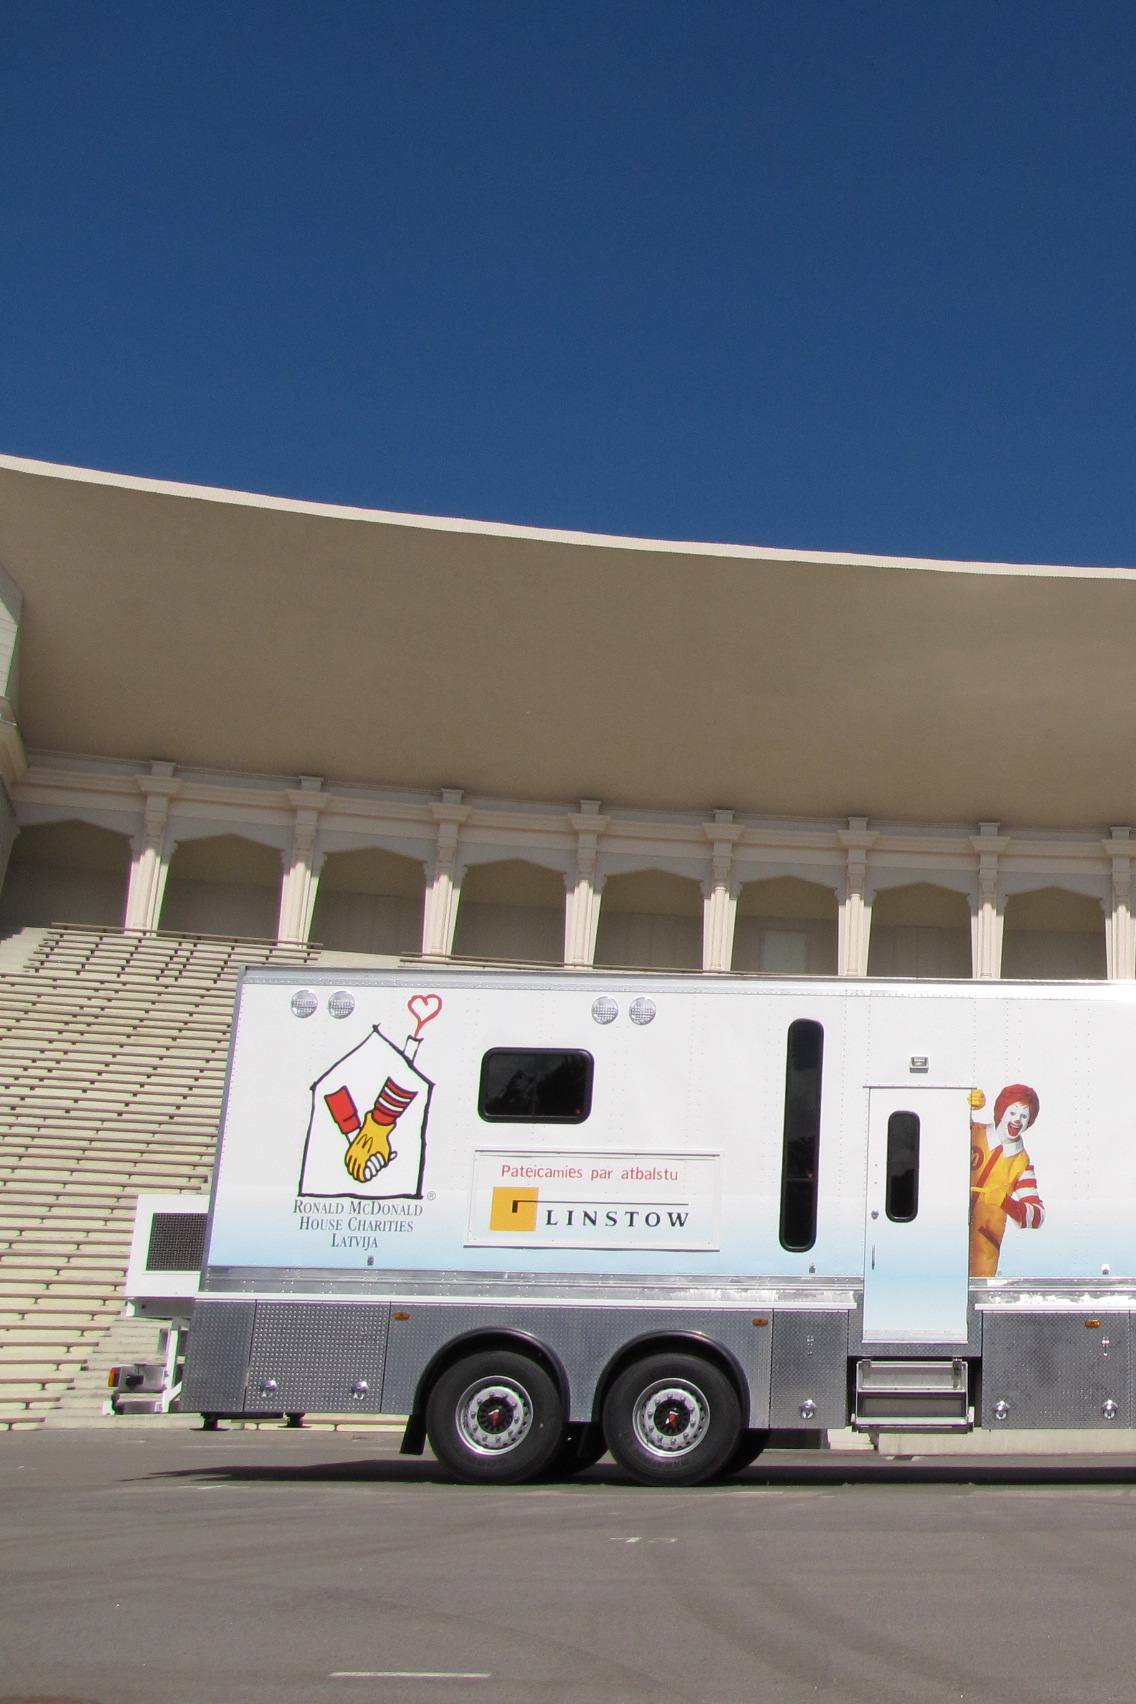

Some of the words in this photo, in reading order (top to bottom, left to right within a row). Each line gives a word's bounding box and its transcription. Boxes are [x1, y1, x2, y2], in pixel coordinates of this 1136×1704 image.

[501, 1164, 583, 1179] Pateicamies
[590, 1168, 614, 1182] par
[620, 1167, 679, 1181] atbalstu
[292, 1199, 345, 1215] RONALD
[299, 1216, 343, 1231] HOUSE
[347, 1216, 414, 1233] CHARITIES
[545, 1209, 689, 1228] LINSTOW
[331, 1232, 379, 1251] LATVIJA
